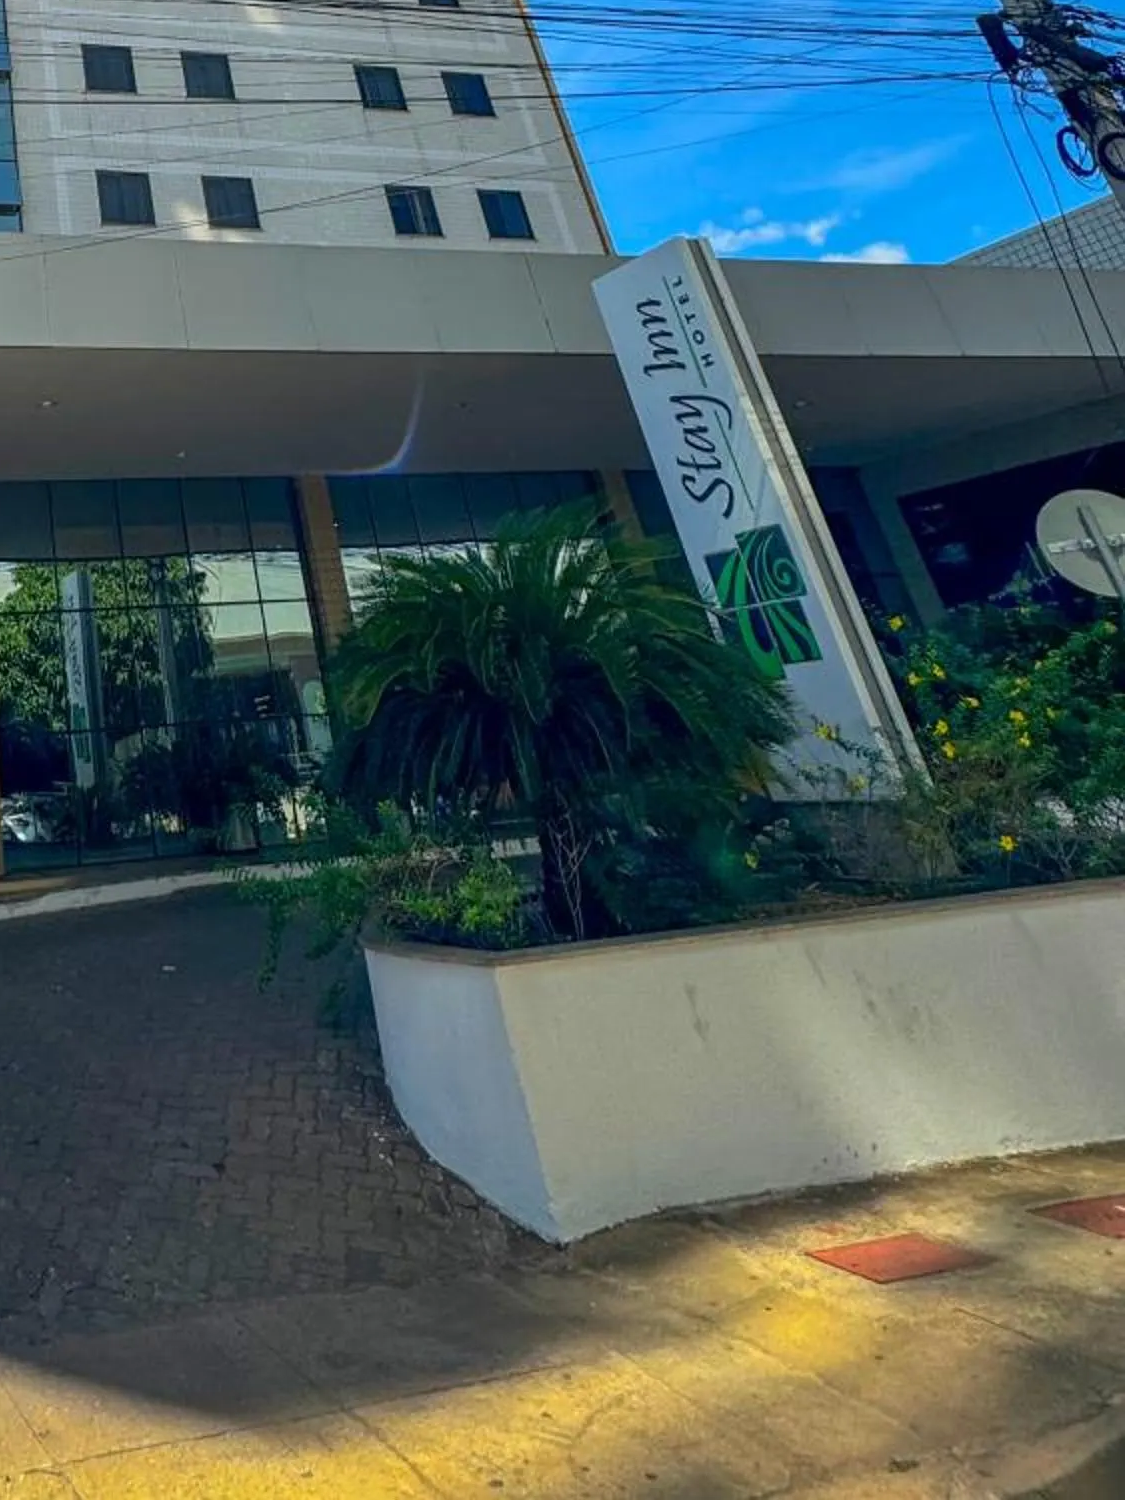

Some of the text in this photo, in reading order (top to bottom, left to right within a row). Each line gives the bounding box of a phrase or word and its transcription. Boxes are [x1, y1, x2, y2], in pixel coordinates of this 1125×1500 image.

[672, 275, 715, 369] HOTEL
[636, 298, 734, 520] Stay Inn
